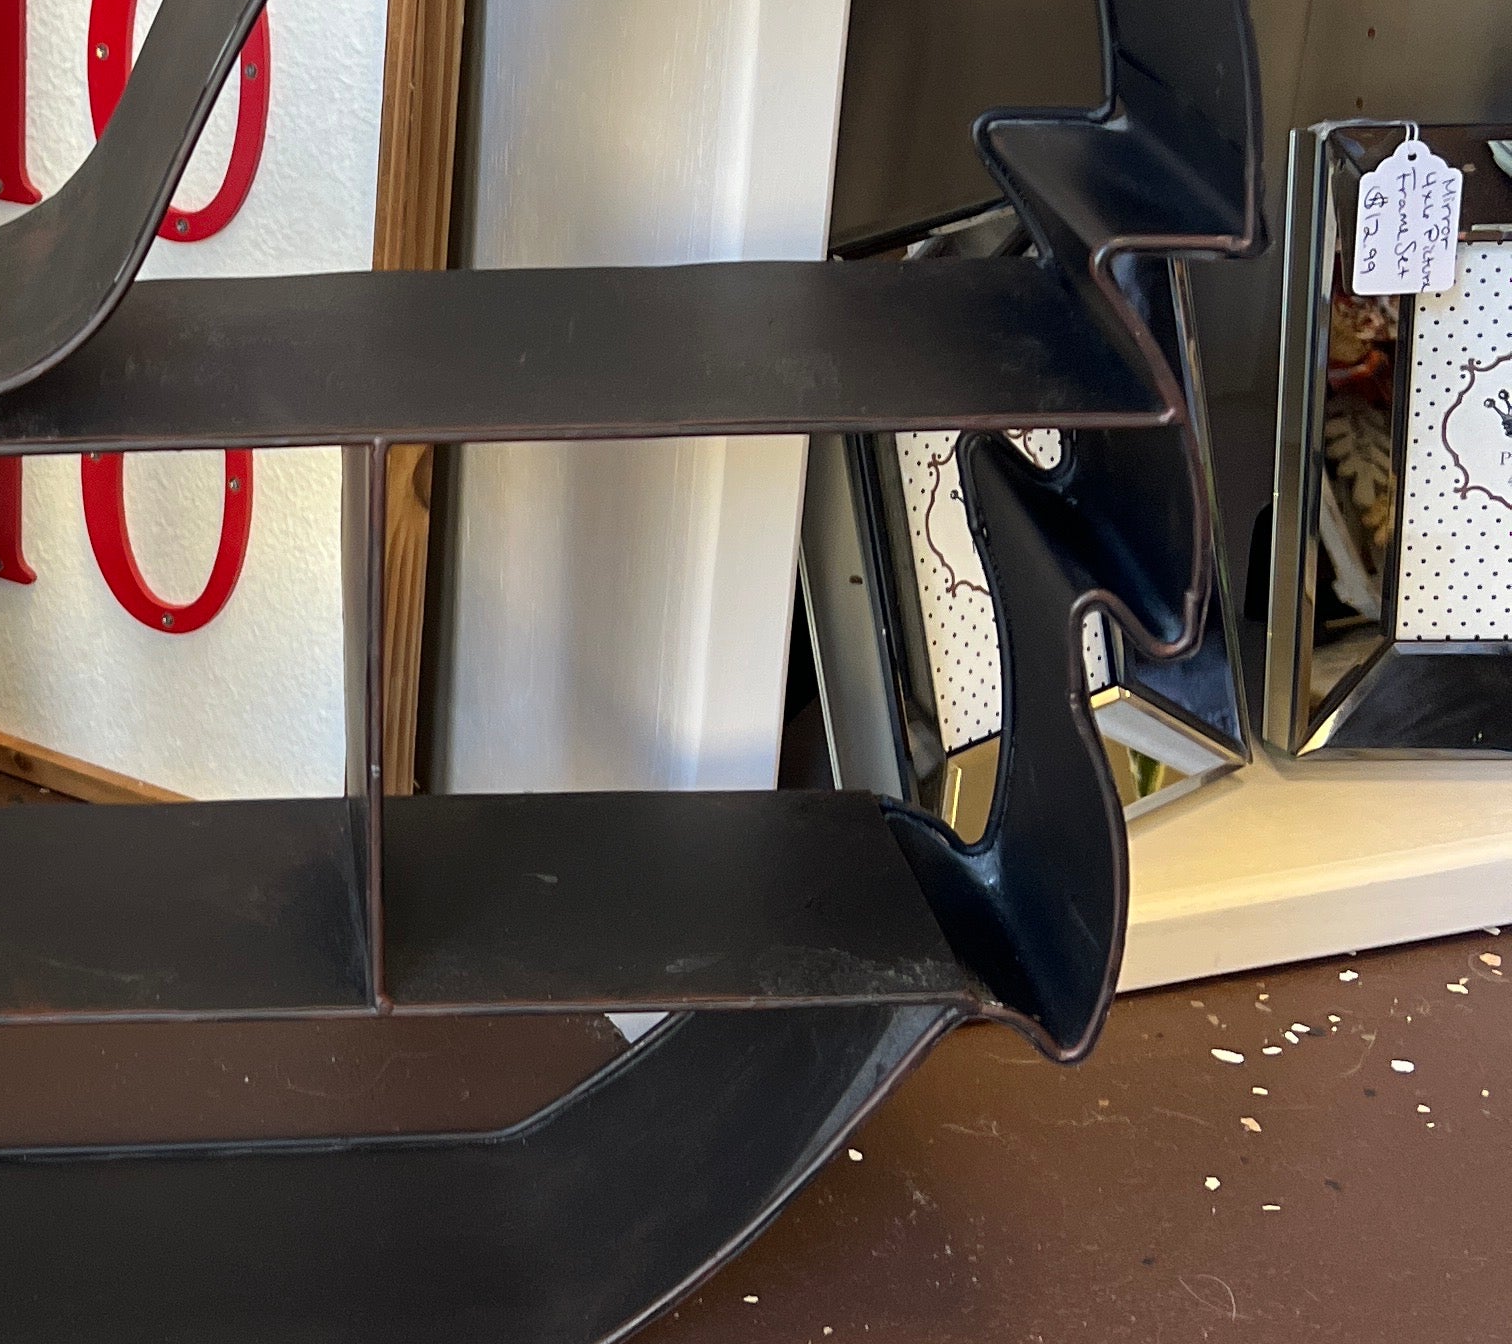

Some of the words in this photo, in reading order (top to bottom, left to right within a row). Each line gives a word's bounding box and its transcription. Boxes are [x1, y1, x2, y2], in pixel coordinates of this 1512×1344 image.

[1359, 185, 1389, 275] $12.99
[1395, 166, 1417, 241] Frame
[1421, 171, 1437, 219] 4x6
[1440, 177, 1456, 250] Mirror
[1394, 240, 1417, 280] Set
[1420, 223, 1439, 293] Picture
